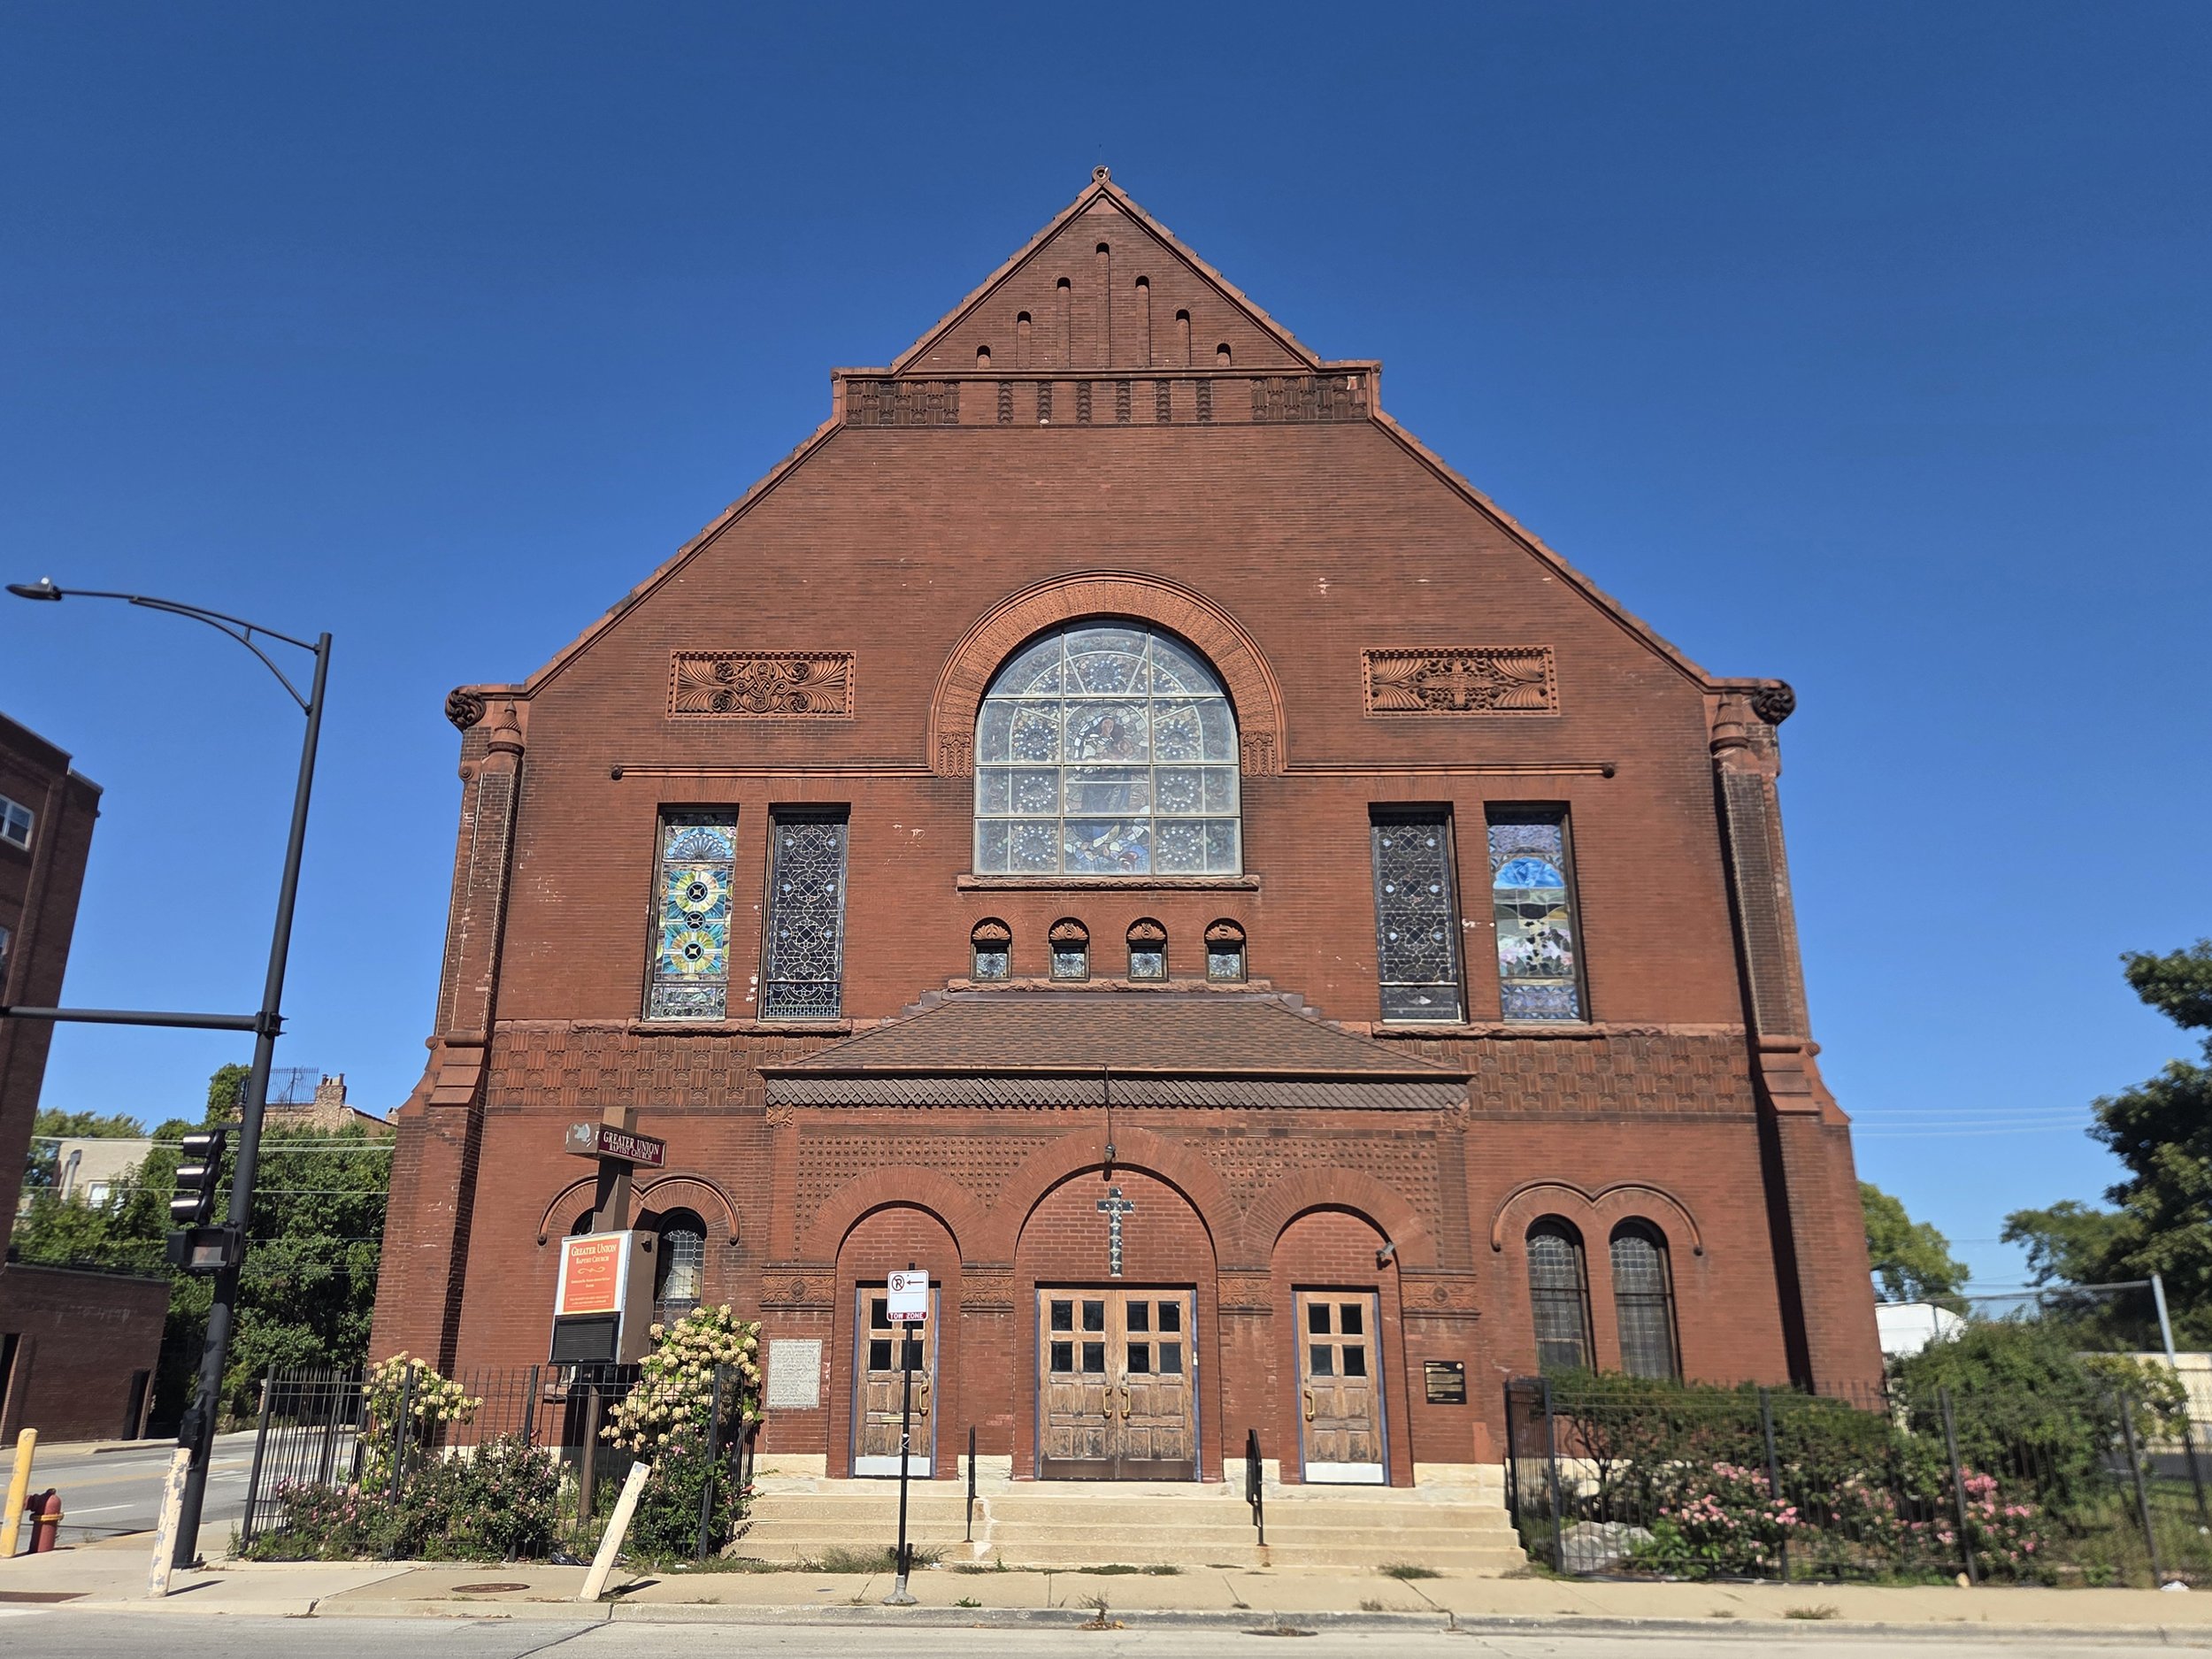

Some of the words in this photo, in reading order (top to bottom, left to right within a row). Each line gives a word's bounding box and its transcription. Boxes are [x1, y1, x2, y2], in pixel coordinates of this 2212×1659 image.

[603, 1131, 634, 1149] GREATER
[637, 1140, 659, 1155] UNION
[609, 1144, 630, 1155] BAPTIST
[631, 1149, 652, 1160] CHURCH
